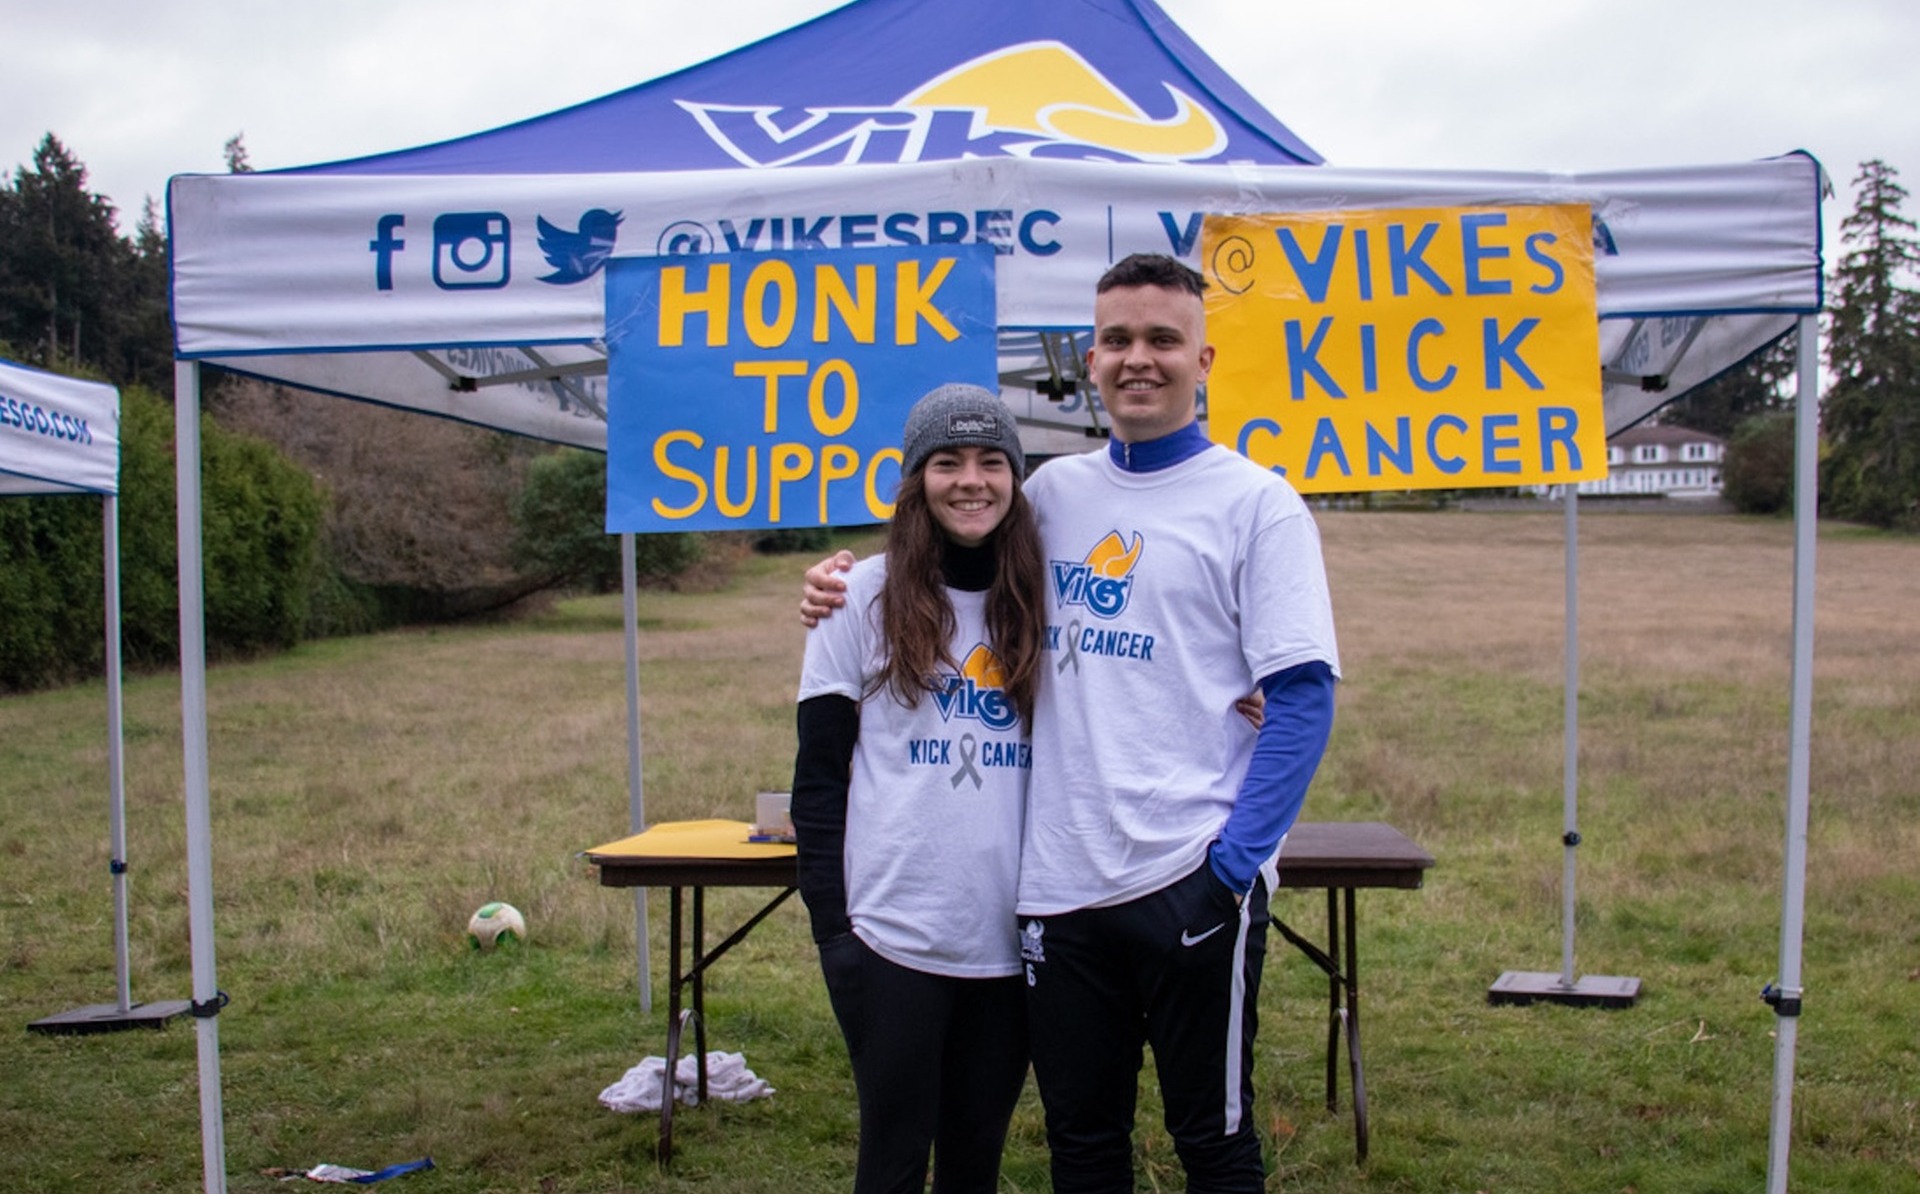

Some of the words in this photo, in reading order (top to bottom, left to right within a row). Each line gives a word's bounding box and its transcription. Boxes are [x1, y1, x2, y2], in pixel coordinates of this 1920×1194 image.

[658, 258, 962, 349] HONK
[1284, 315, 1546, 401] KICK
[733, 359, 859, 436] TO
[651, 430, 904, 524] SUPPO
[1237, 407, 1583, 479] CANCER
[1050, 560, 1134, 620] Vikes
[1081, 627, 1155, 660] CANCER
[910, 739, 951, 765] KICK
